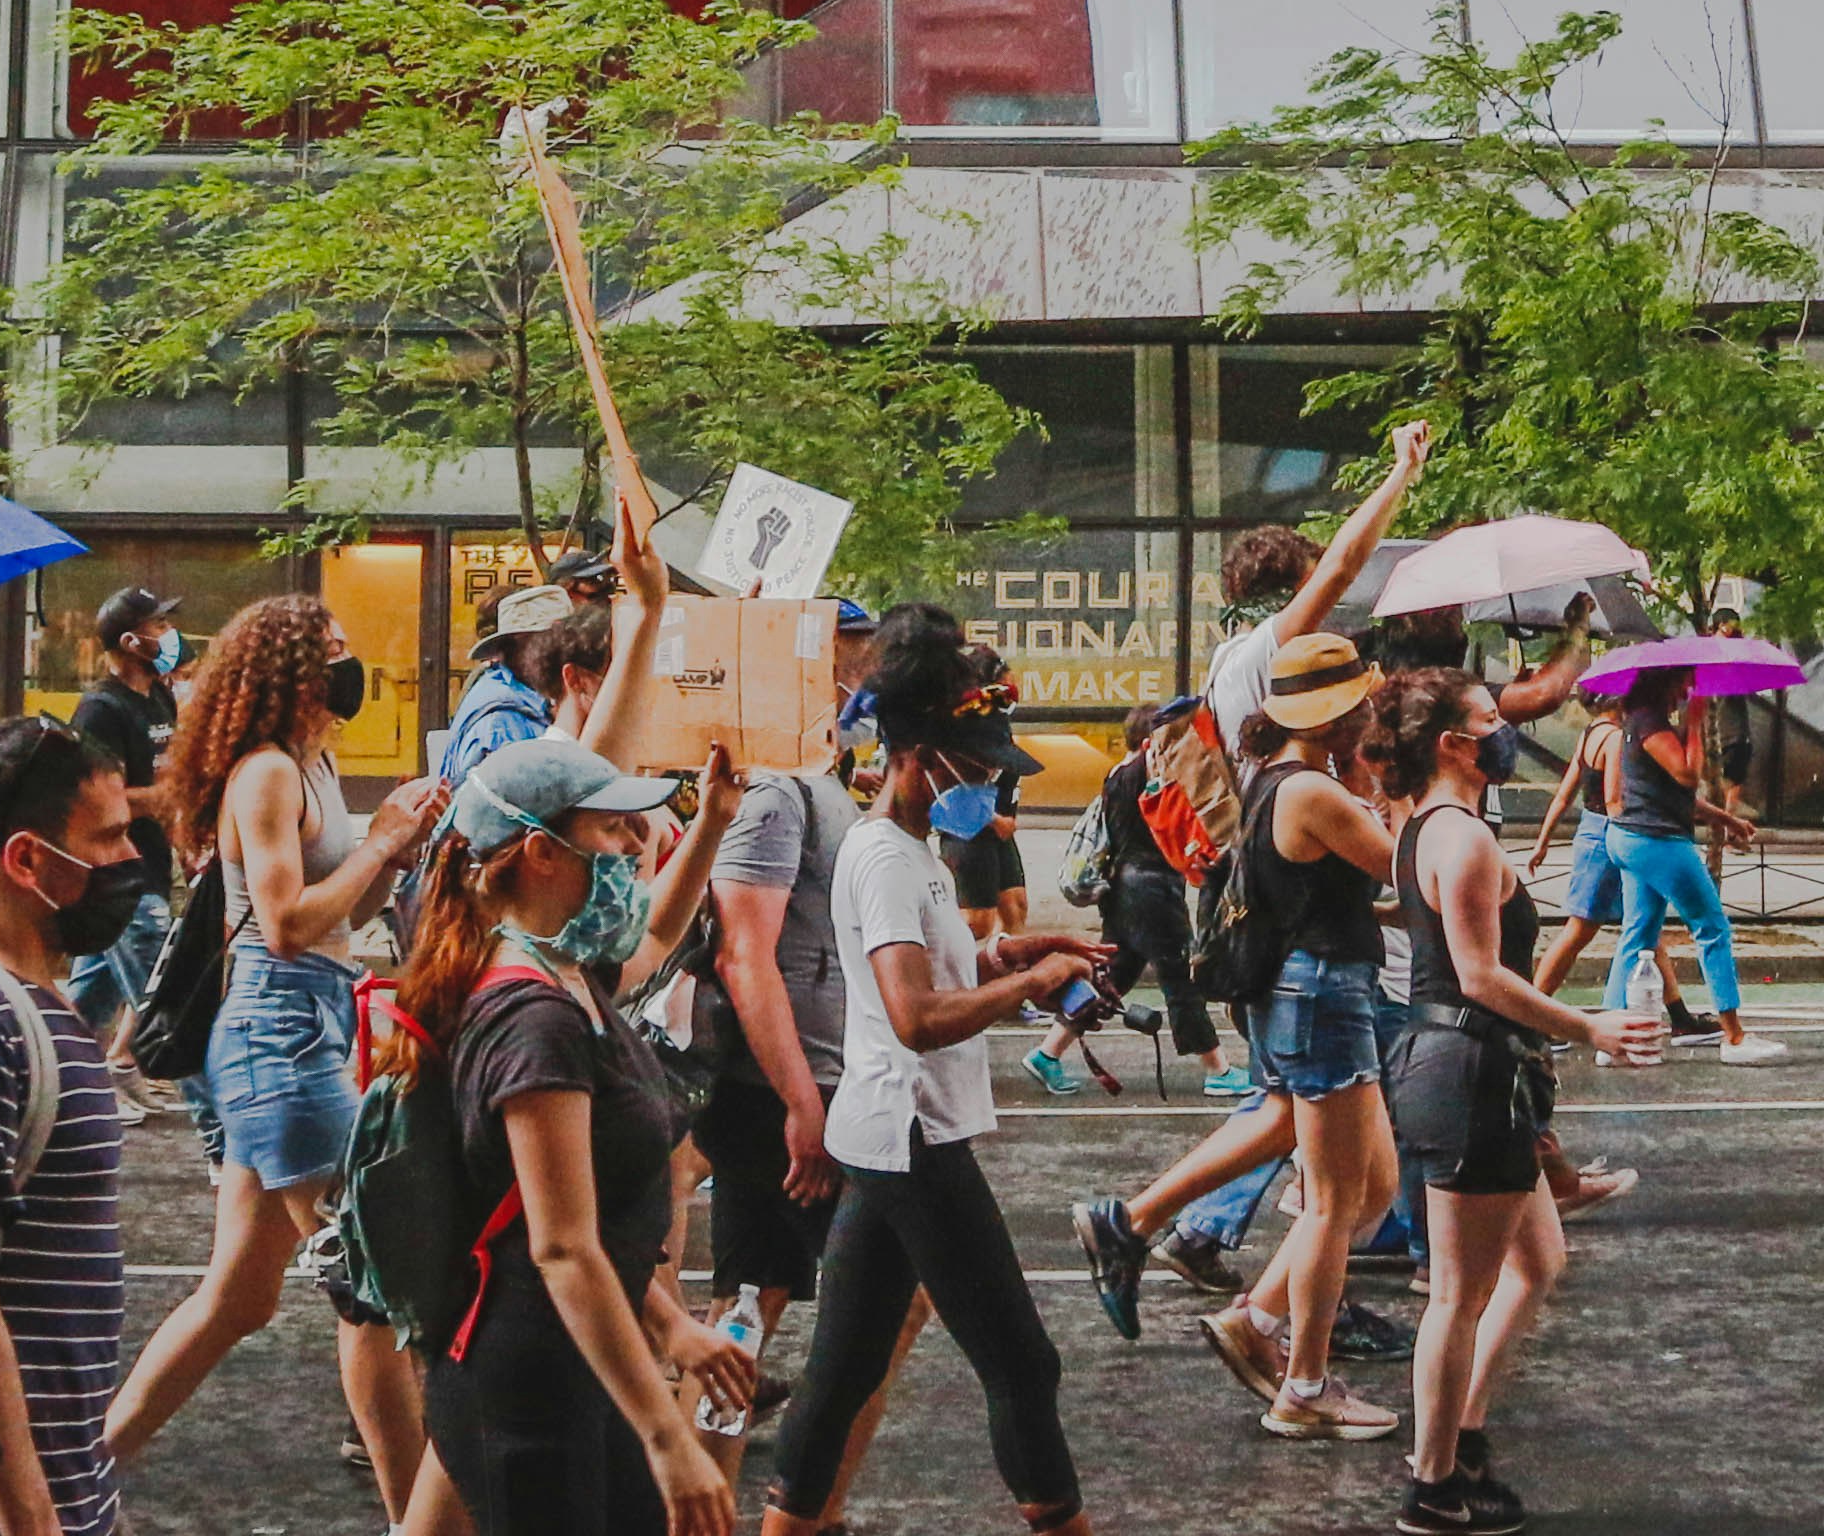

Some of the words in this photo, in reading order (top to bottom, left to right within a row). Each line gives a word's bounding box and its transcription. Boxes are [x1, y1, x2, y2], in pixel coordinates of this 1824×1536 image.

[723, 550, 752, 593] JUSTIC
[995, 571, 1228, 609] COURA
[1023, 670, 1161, 702] MAKE
